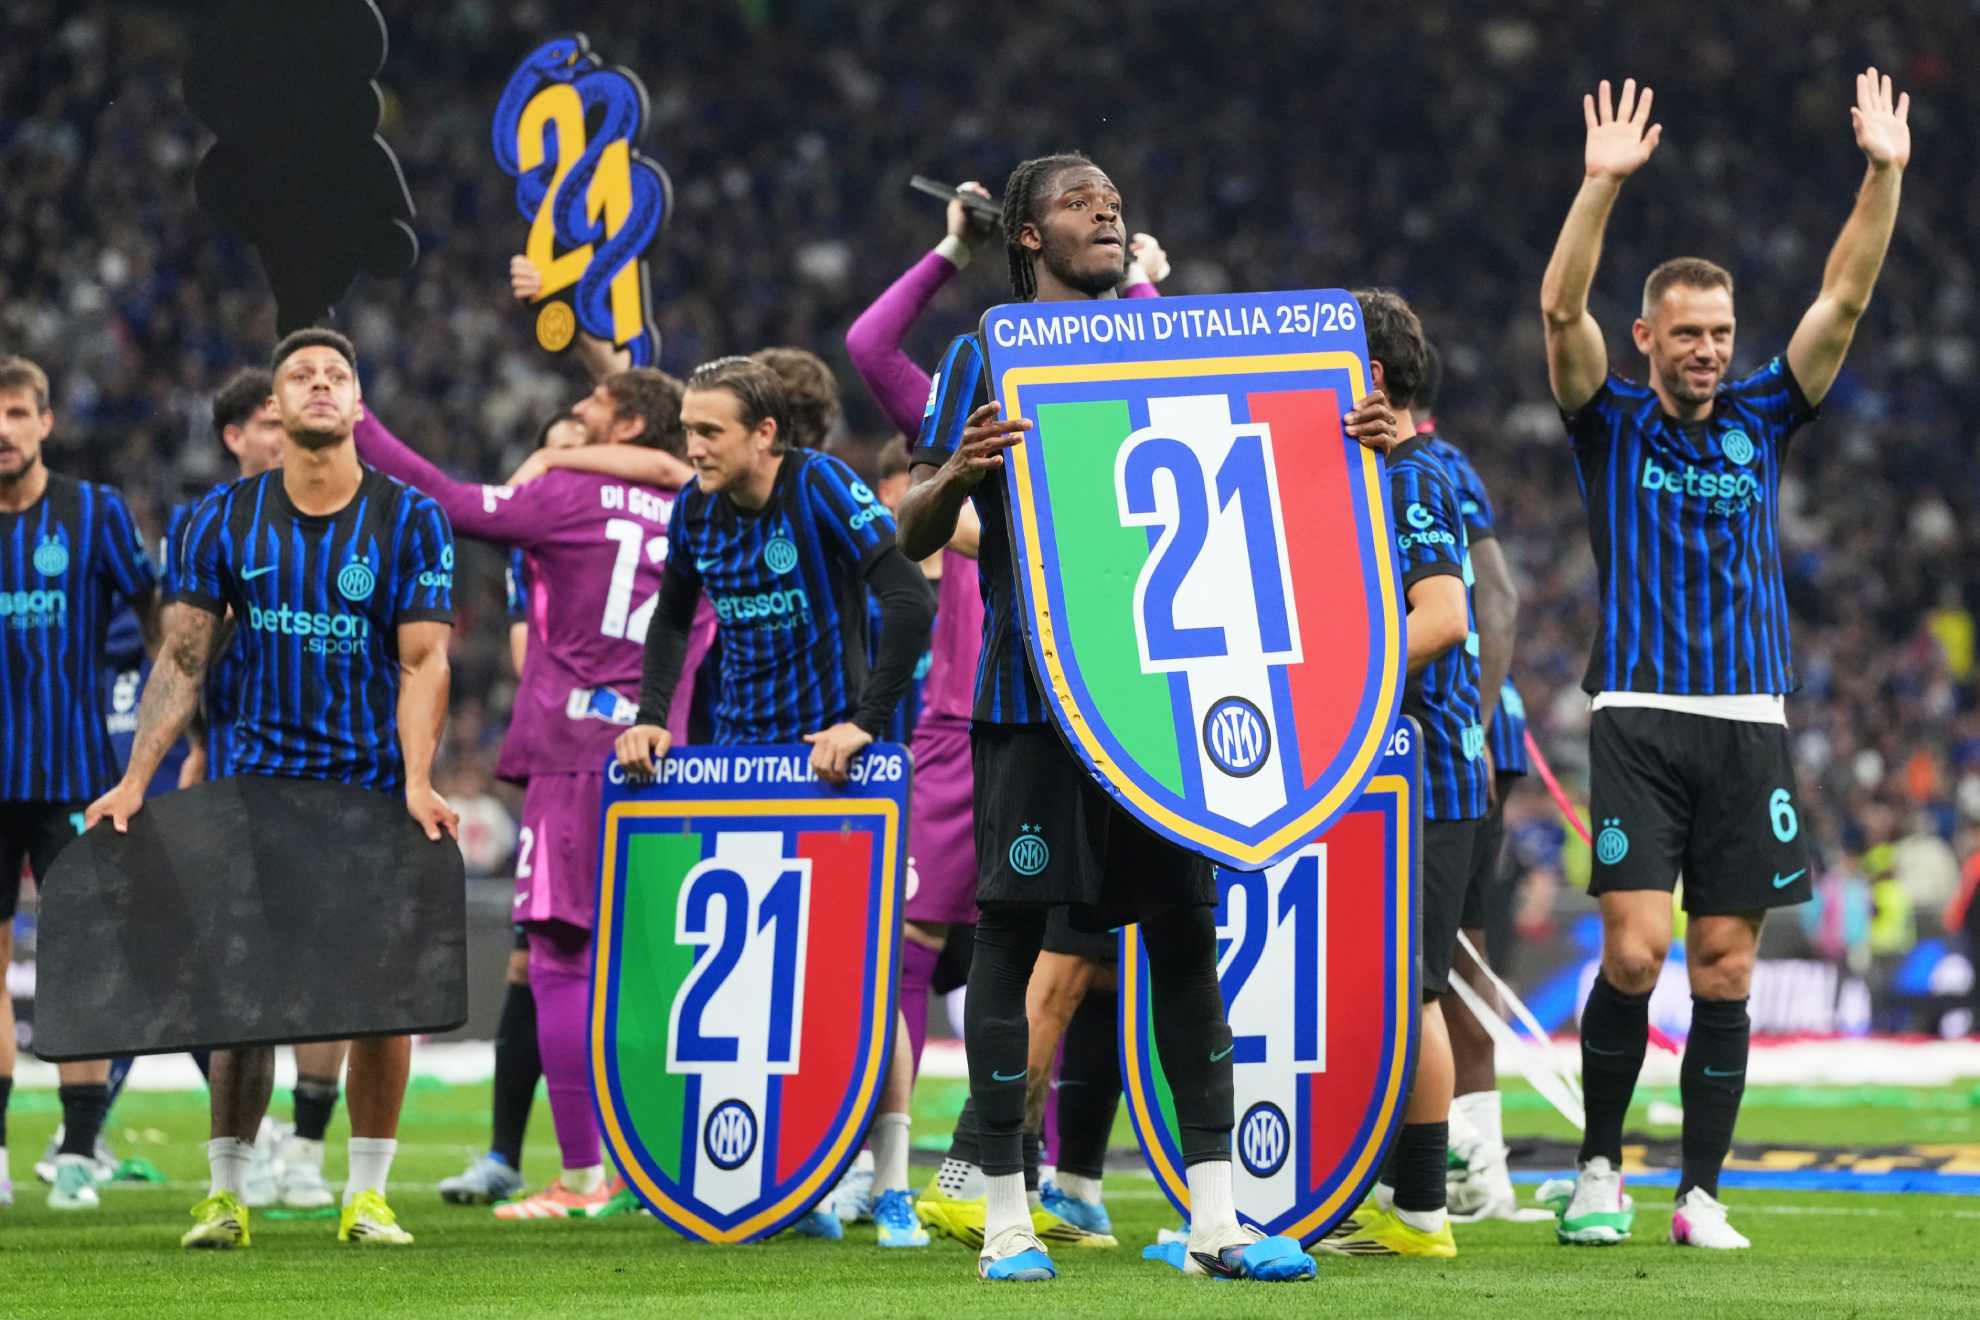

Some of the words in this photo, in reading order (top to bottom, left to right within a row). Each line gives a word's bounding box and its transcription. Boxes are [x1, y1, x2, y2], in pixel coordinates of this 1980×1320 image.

[994, 313, 1145, 348] CAMPIONI
[1152, 306, 1271, 341] D'ITALIA
[1276, 302, 1357, 337] 25/26
[601, 485, 624, 510] DI
[1118, 429, 1299, 668] 21
[249, 601, 369, 638] betsson
[714, 588, 808, 620] etsson
[304, 637, 367, 656] .sport
[734, 755, 820, 783] D'ITALI
[849, 754, 902, 786] 5/26
[1769, 787, 1799, 843] 6
[671, 863, 807, 1068] 21
[1216, 850, 1323, 1068] 21
